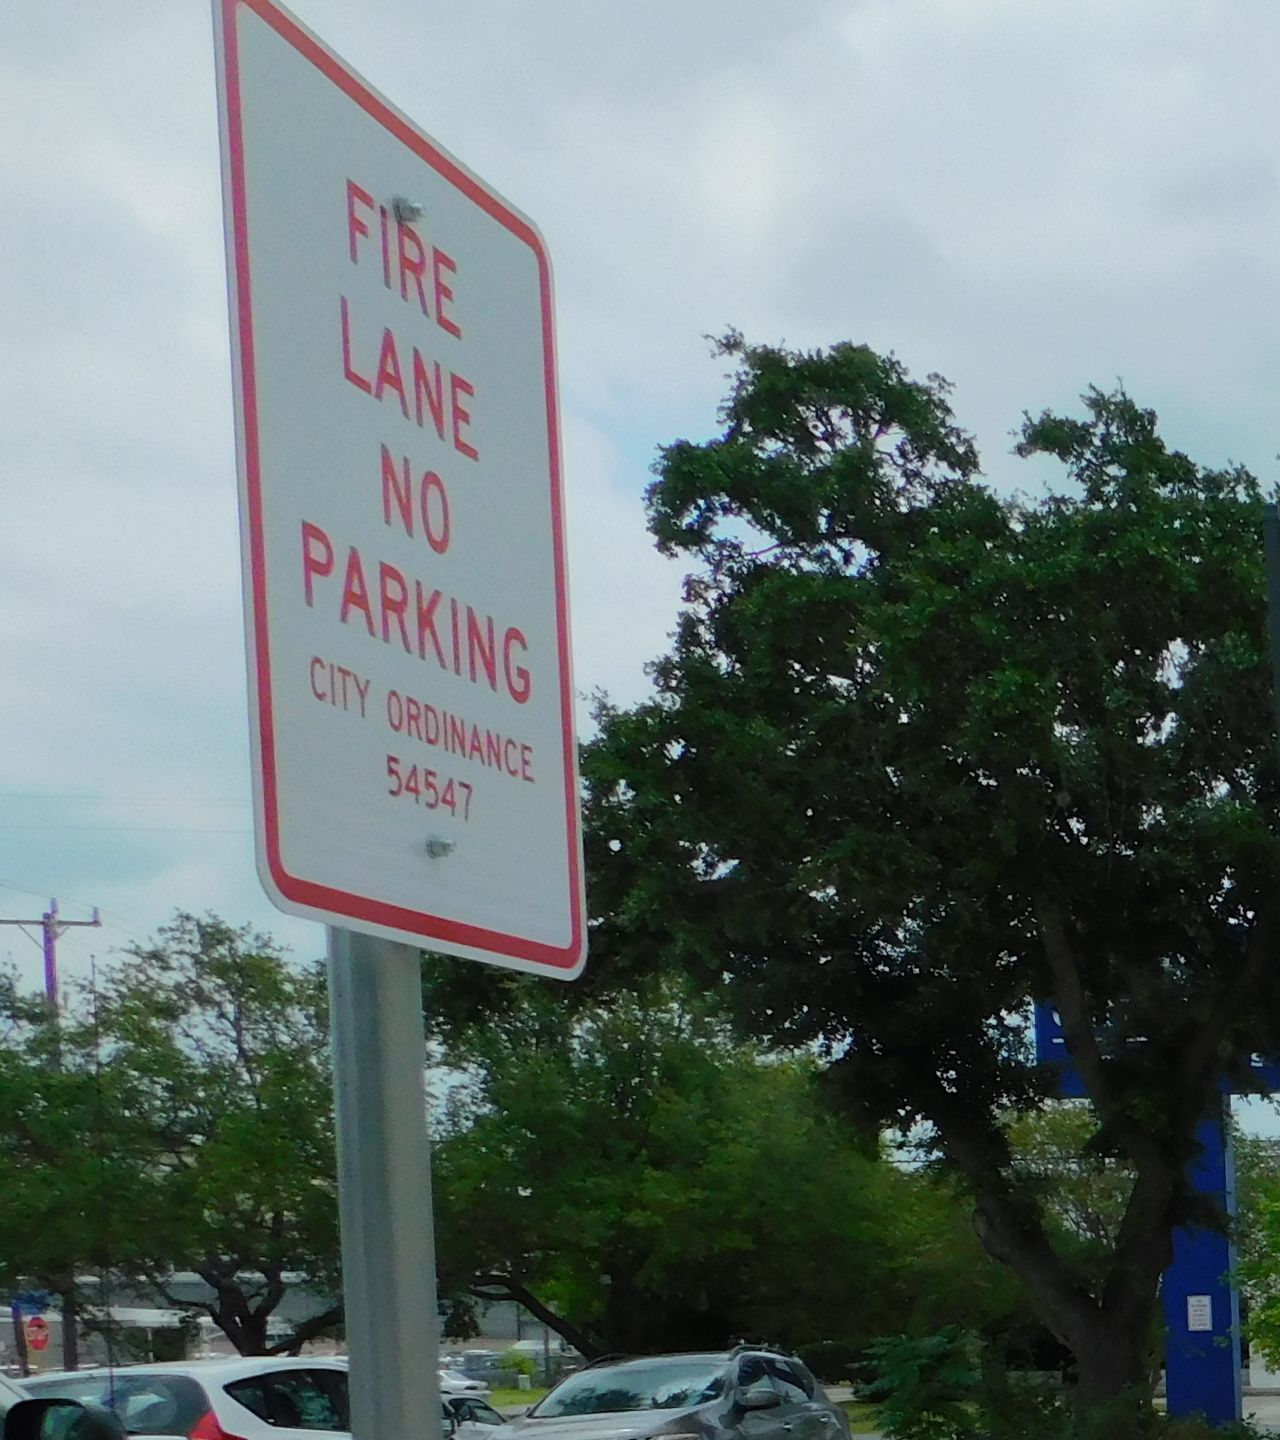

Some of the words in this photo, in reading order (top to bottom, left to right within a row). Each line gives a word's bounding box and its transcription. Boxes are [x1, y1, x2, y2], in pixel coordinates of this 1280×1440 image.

[347, 178, 461, 340] FIRE
[341, 294, 478, 463] LANE
[380, 442, 451, 556] NO
[301, 518, 532, 706] PARKING
[309, 655, 370, 720] CITY
[387, 687, 535, 784] ORDINANCE
[386, 753, 474, 822] 54547
